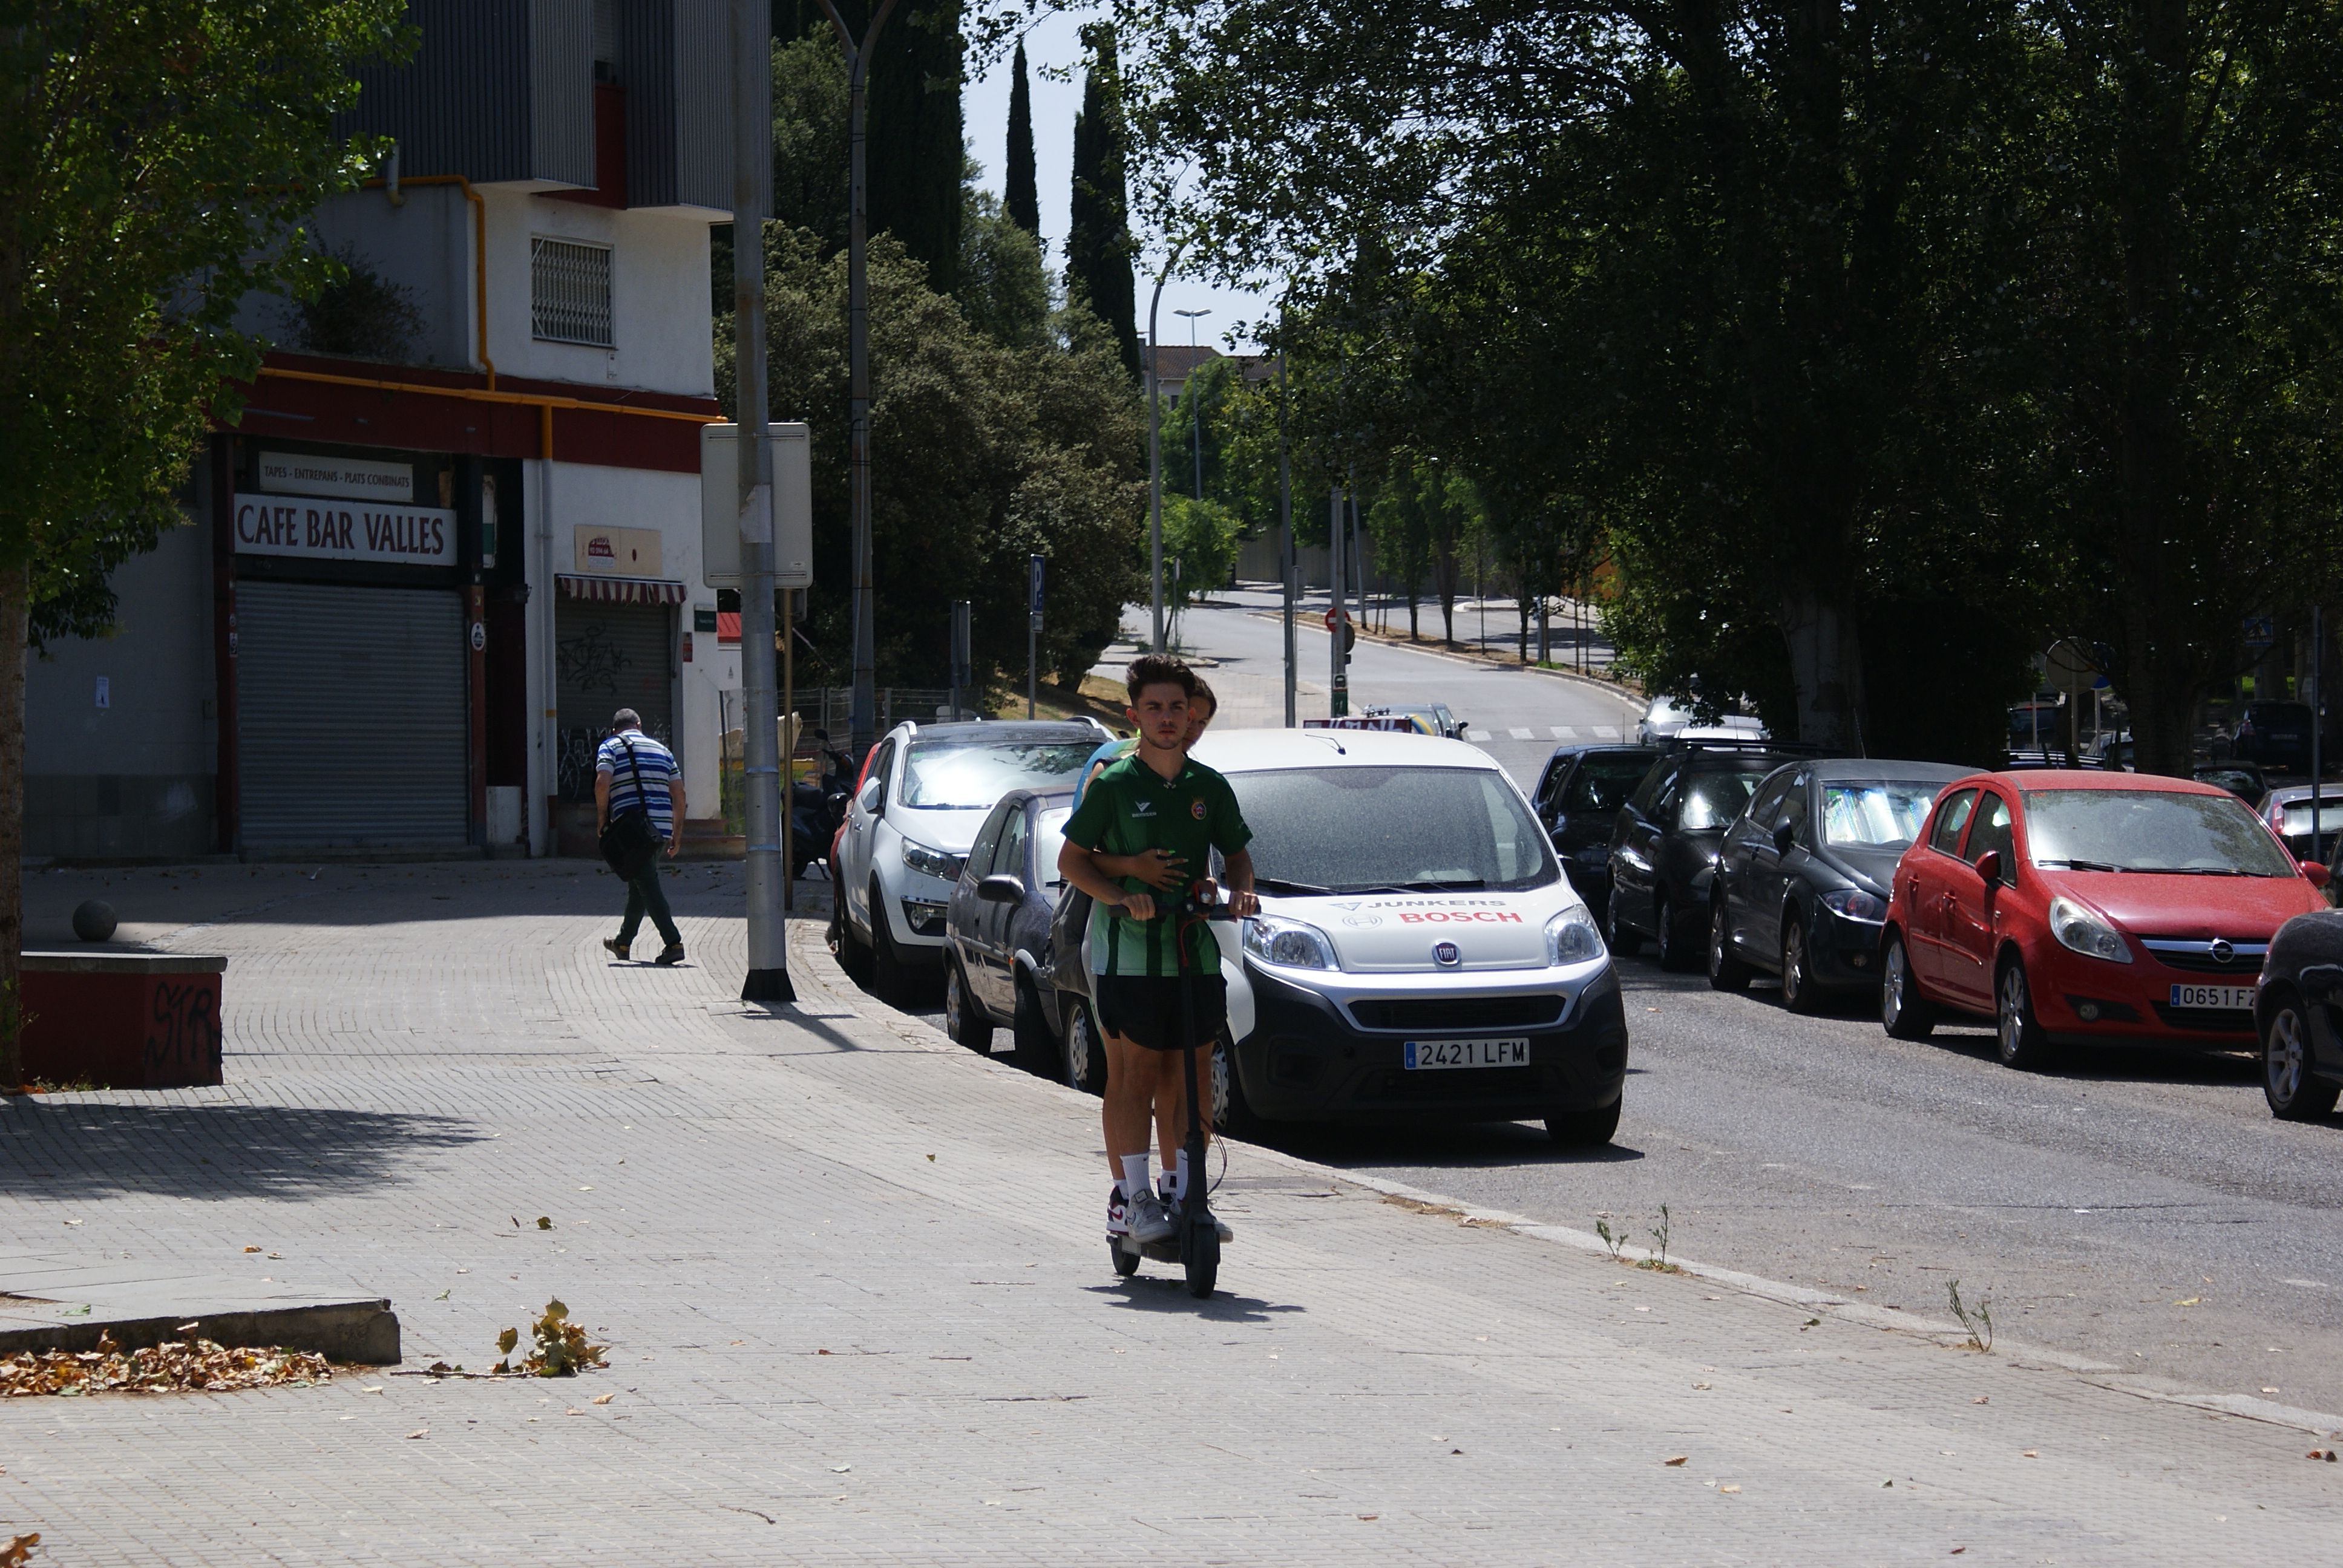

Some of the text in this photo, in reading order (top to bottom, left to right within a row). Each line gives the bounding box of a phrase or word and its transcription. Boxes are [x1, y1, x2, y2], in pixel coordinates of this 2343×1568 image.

[264, 465, 287, 478] TAPES
[294, 467, 338, 482] ENTREPANS
[345, 471, 365, 485] PLATS
[237, 505, 445, 555] CAFE BAR VALLES
[1398, 912, 1524, 923] BOSCH
[1438, 947, 1455, 959] FIAT
[2183, 987, 2229, 1006] 0651
[1421, 1044, 1473, 1065] 2421
[1484, 1042, 1524, 1063] LFM
